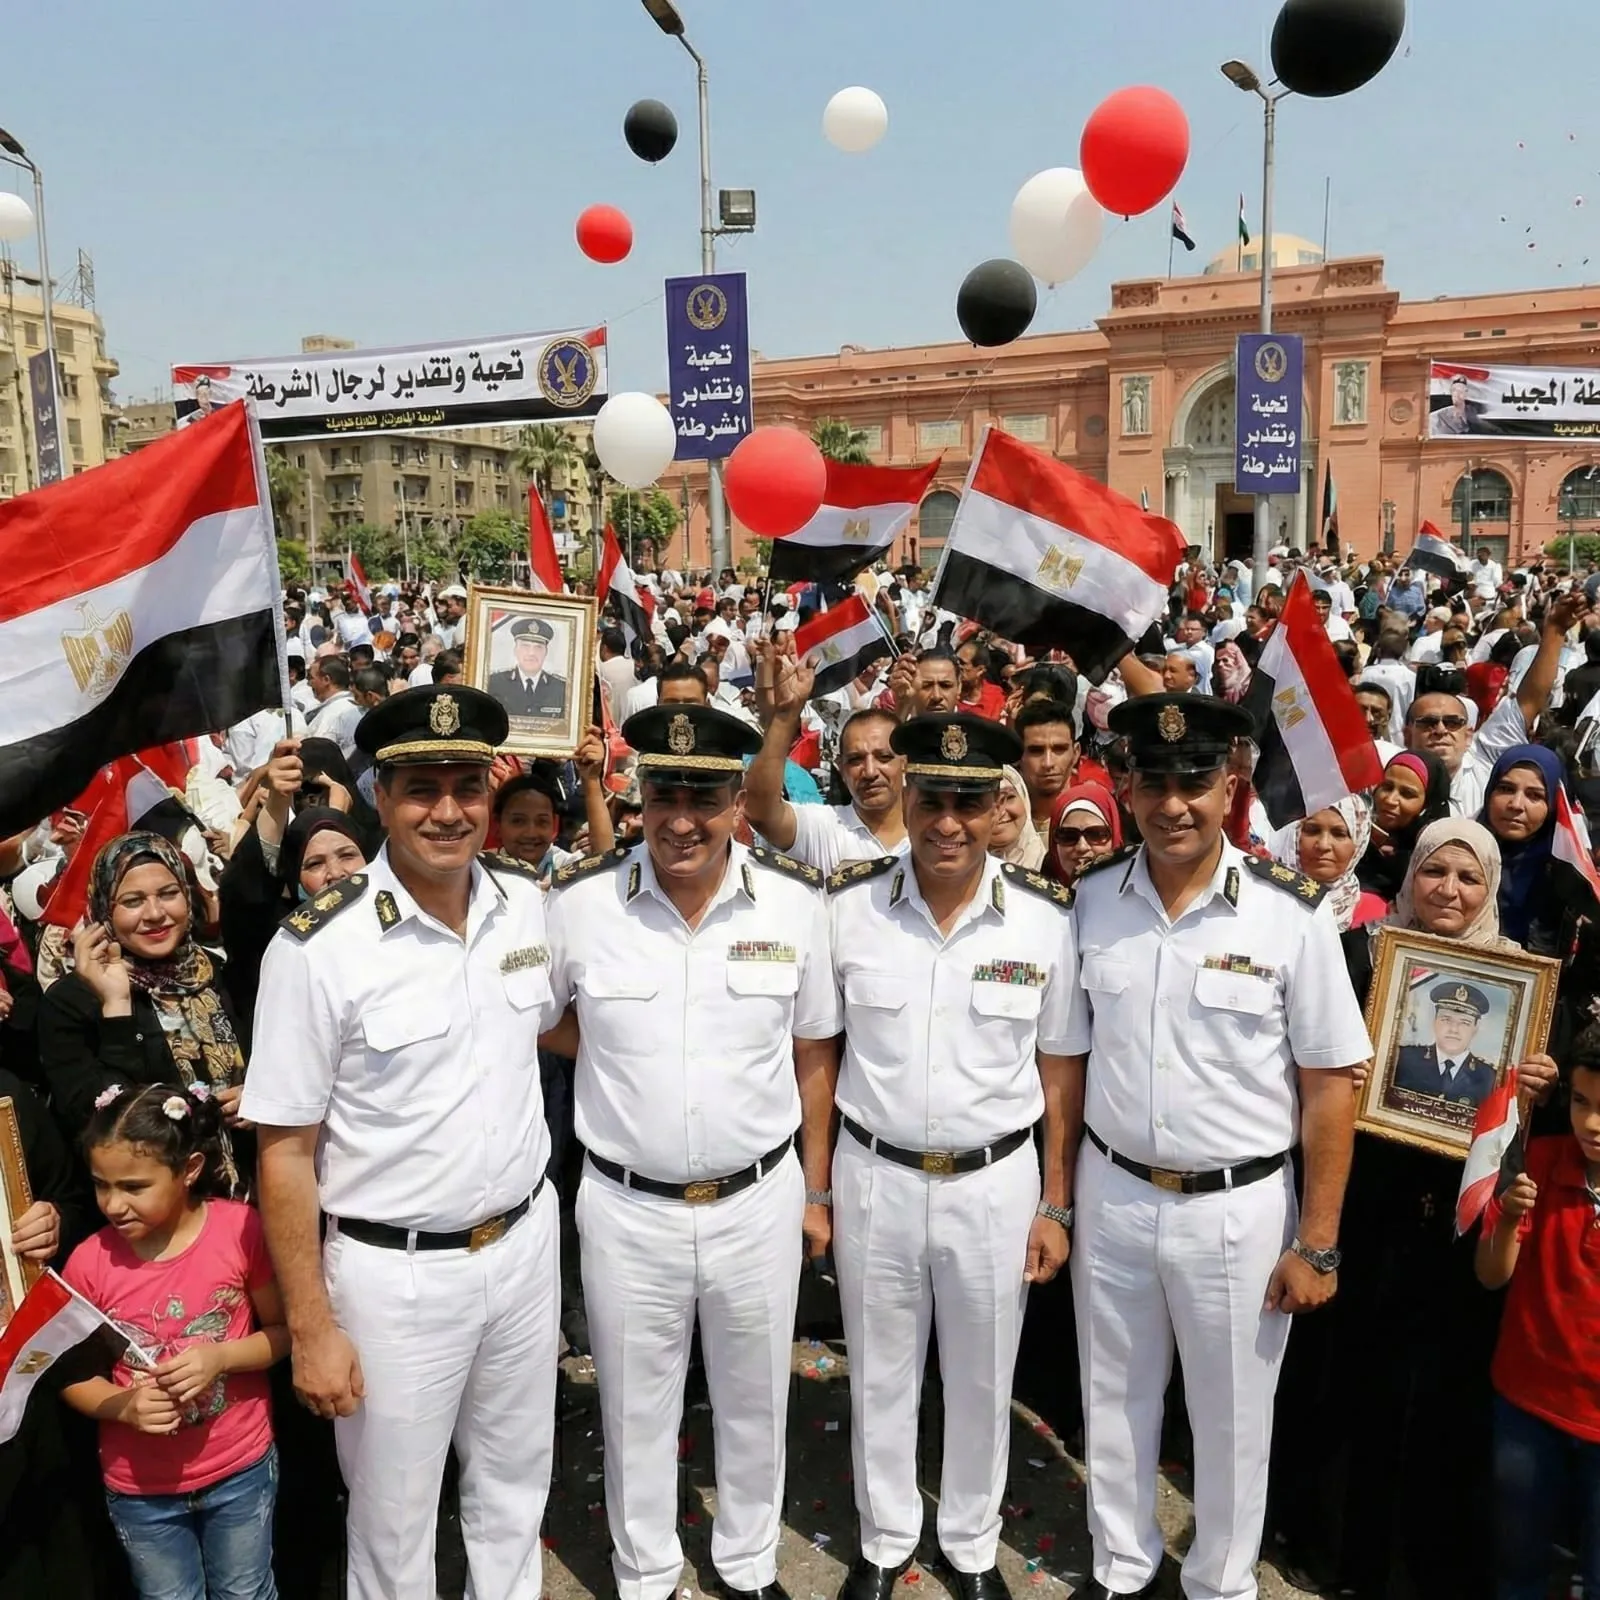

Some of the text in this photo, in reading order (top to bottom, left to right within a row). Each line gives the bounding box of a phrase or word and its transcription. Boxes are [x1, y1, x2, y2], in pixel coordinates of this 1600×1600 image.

[684, 344, 733, 371] تحية
[245, 349, 524, 407] تحية وتقدير لرجال الشرطة
[1251, 394, 1288, 418] تحية
[1501, 377, 1566, 412] المجيد
[676, 412, 747, 441] الشرطة
[1242, 453, 1296, 478] الشرطة
